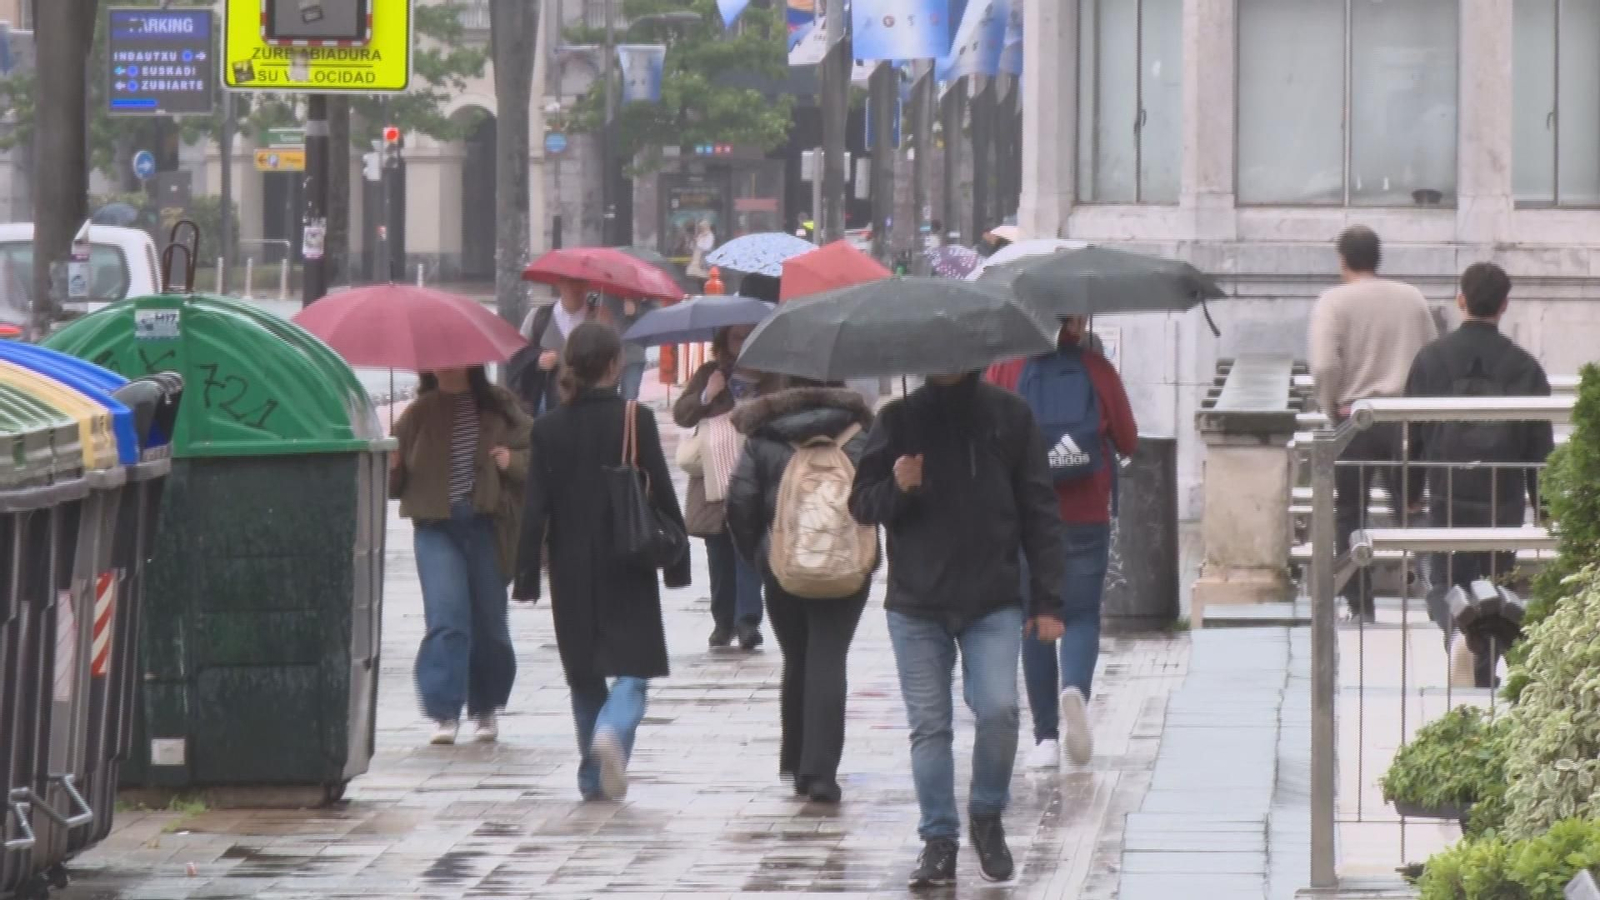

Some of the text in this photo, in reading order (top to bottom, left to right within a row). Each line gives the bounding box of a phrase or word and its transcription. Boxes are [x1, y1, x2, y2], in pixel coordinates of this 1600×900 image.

[113, 51, 177, 61] INDAUTXU
[299, 47, 382, 61] ABIADURA
[141, 66, 196, 76] EUSKADI
[258, 70, 376, 83] SU VOCIDAD
[141, 80, 204, 90] ZUBIARTE
